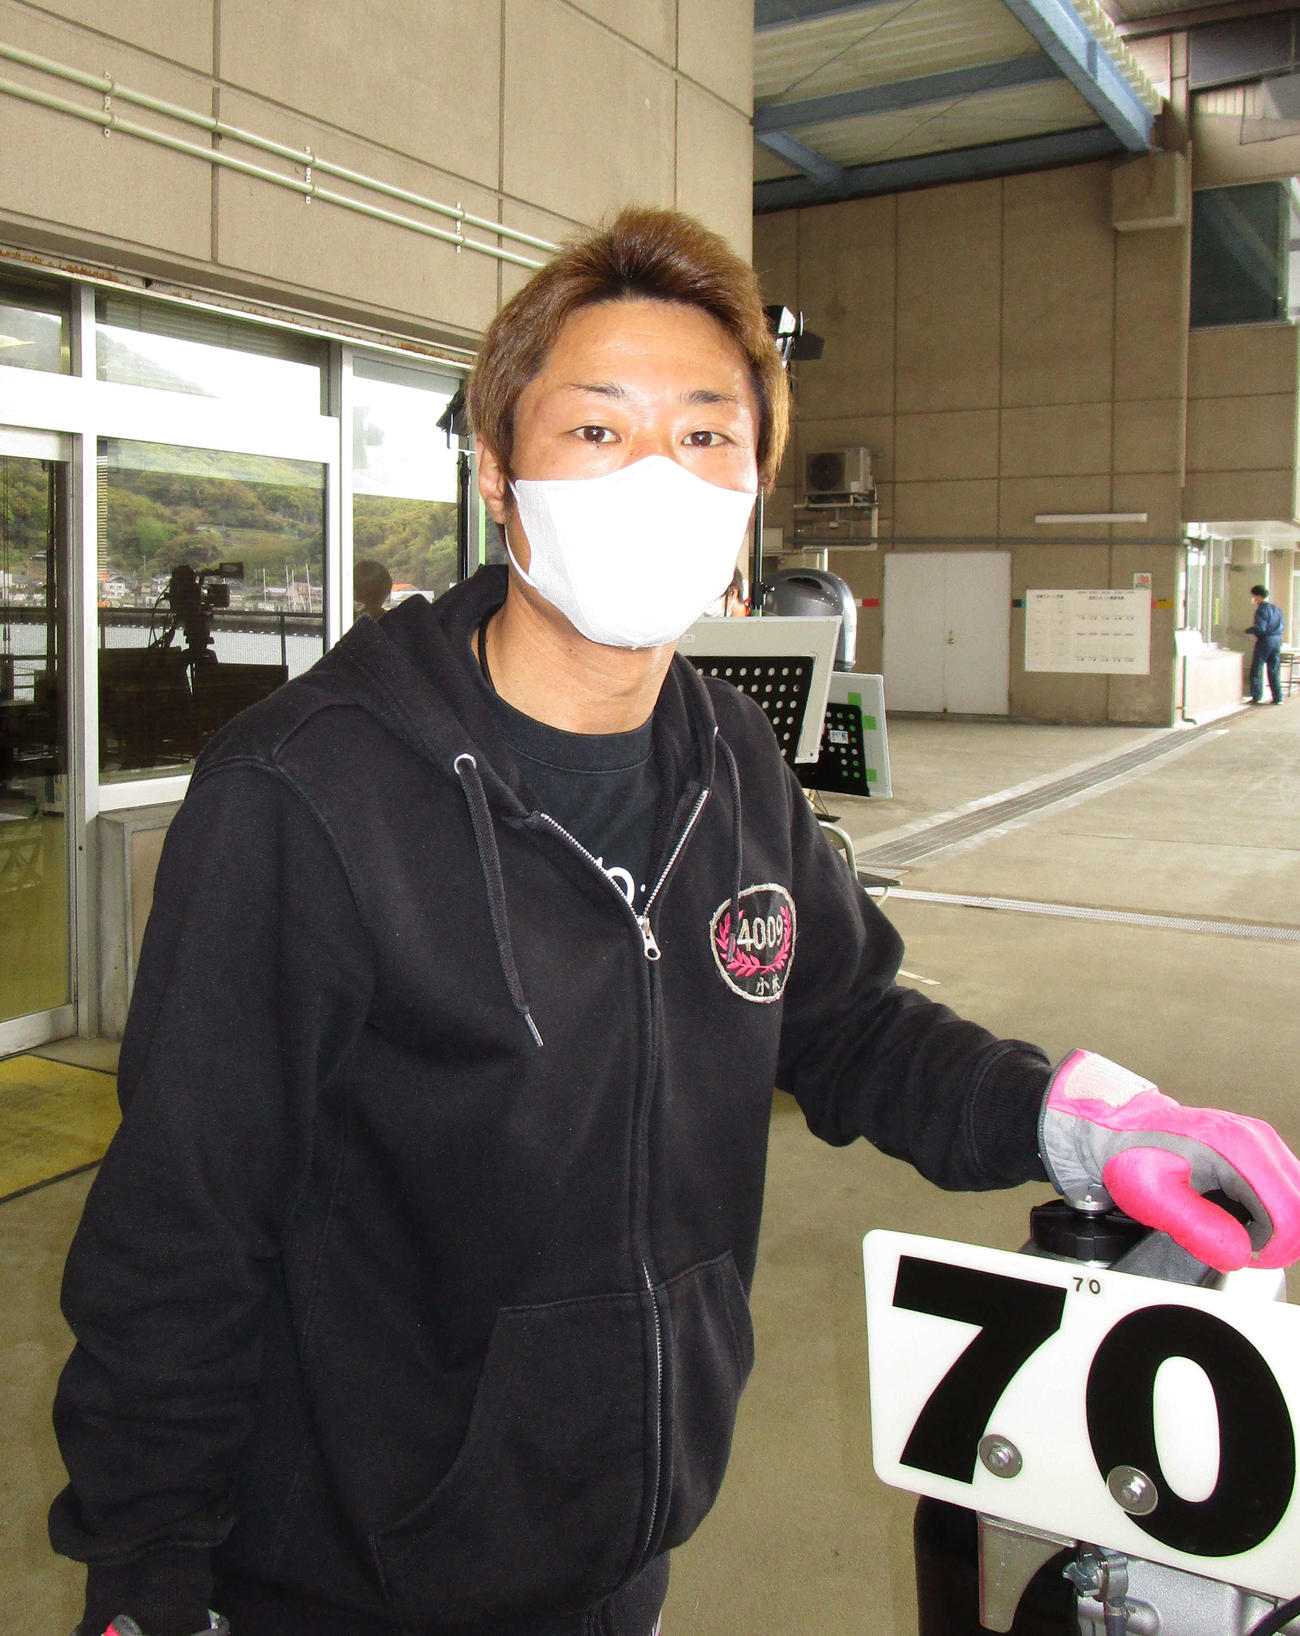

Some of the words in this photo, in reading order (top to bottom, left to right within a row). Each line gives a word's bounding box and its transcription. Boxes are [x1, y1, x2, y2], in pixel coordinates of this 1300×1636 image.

[737, 914, 784, 951] 4009
[1072, 1276, 1101, 1294] 70
[892, 1254, 1296, 1558] 70
